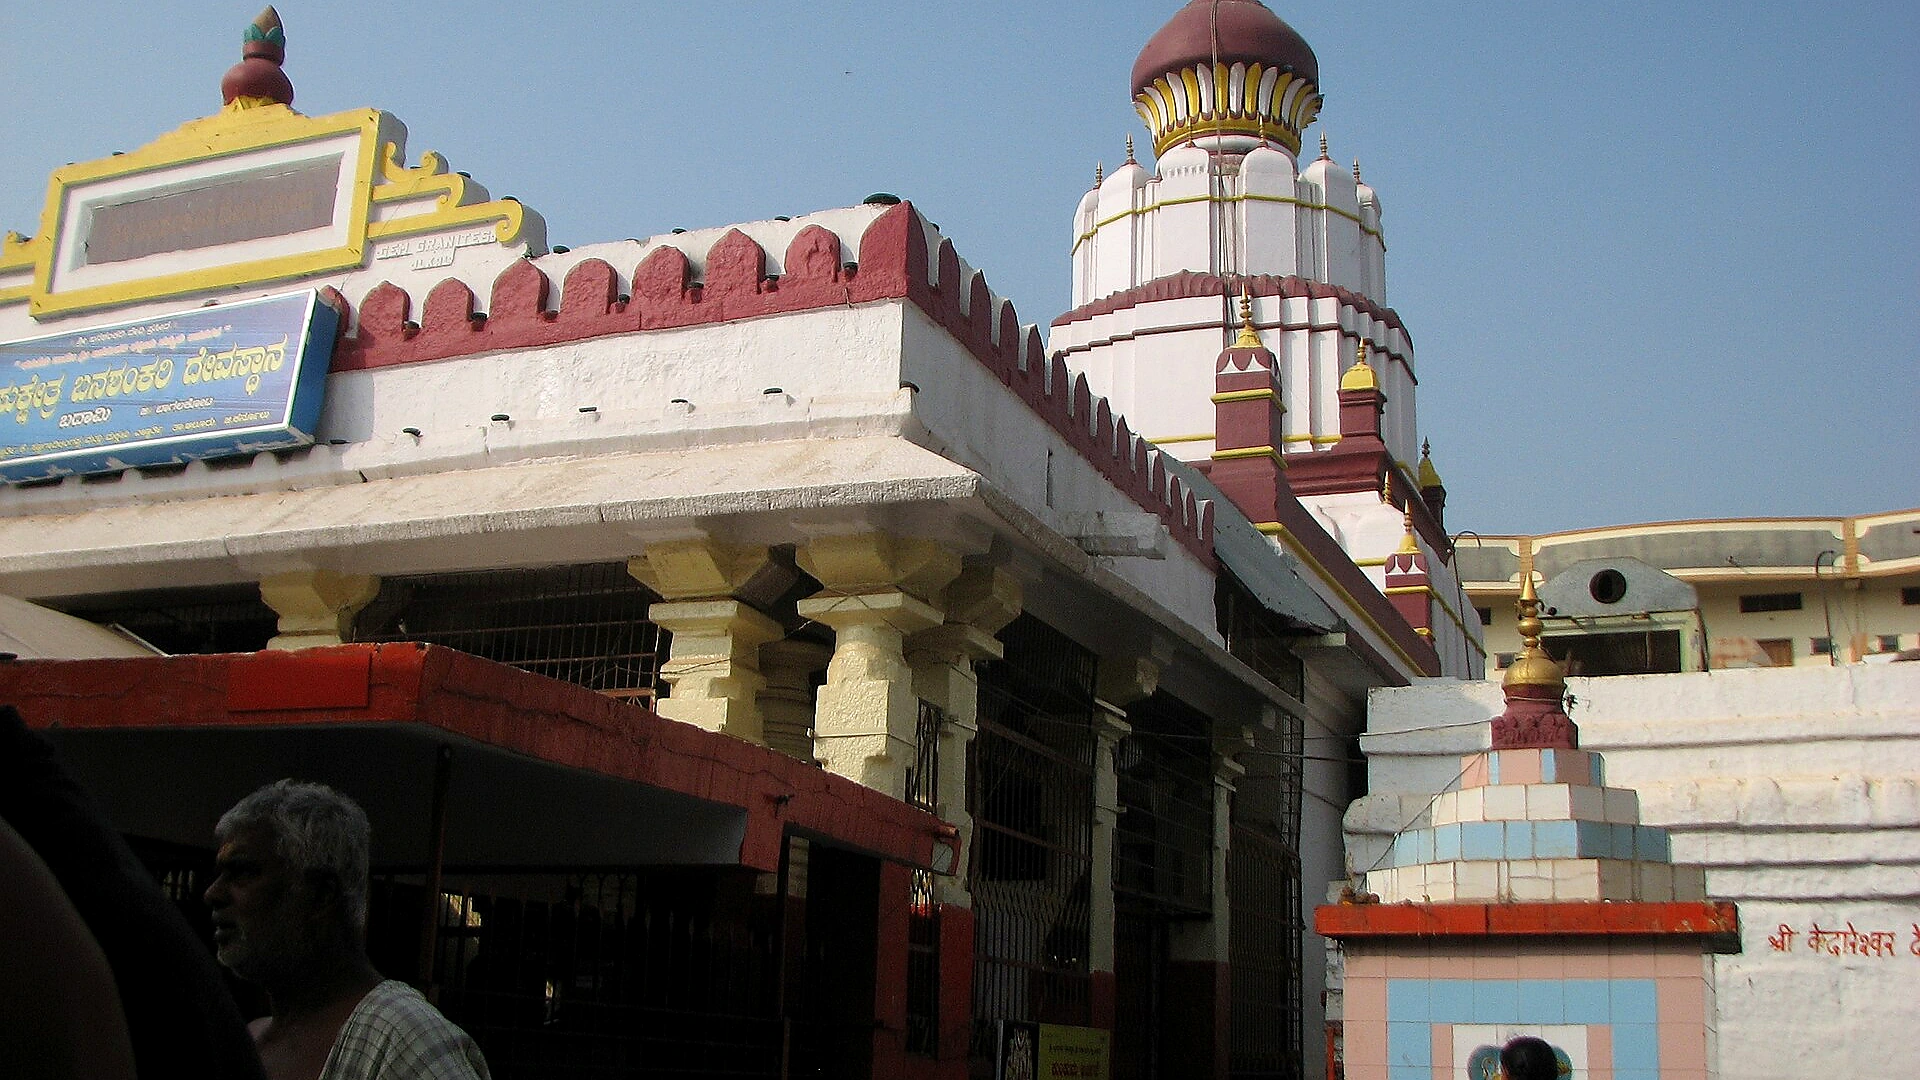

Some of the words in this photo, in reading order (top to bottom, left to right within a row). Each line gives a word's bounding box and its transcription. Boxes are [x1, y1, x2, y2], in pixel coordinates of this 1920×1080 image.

[71, 354, 175, 403] ಬನಶಂಕರಿ
[58, 406, 112, 428] ಬದಾಮಿ
[1767, 923, 1800, 952] श्री
